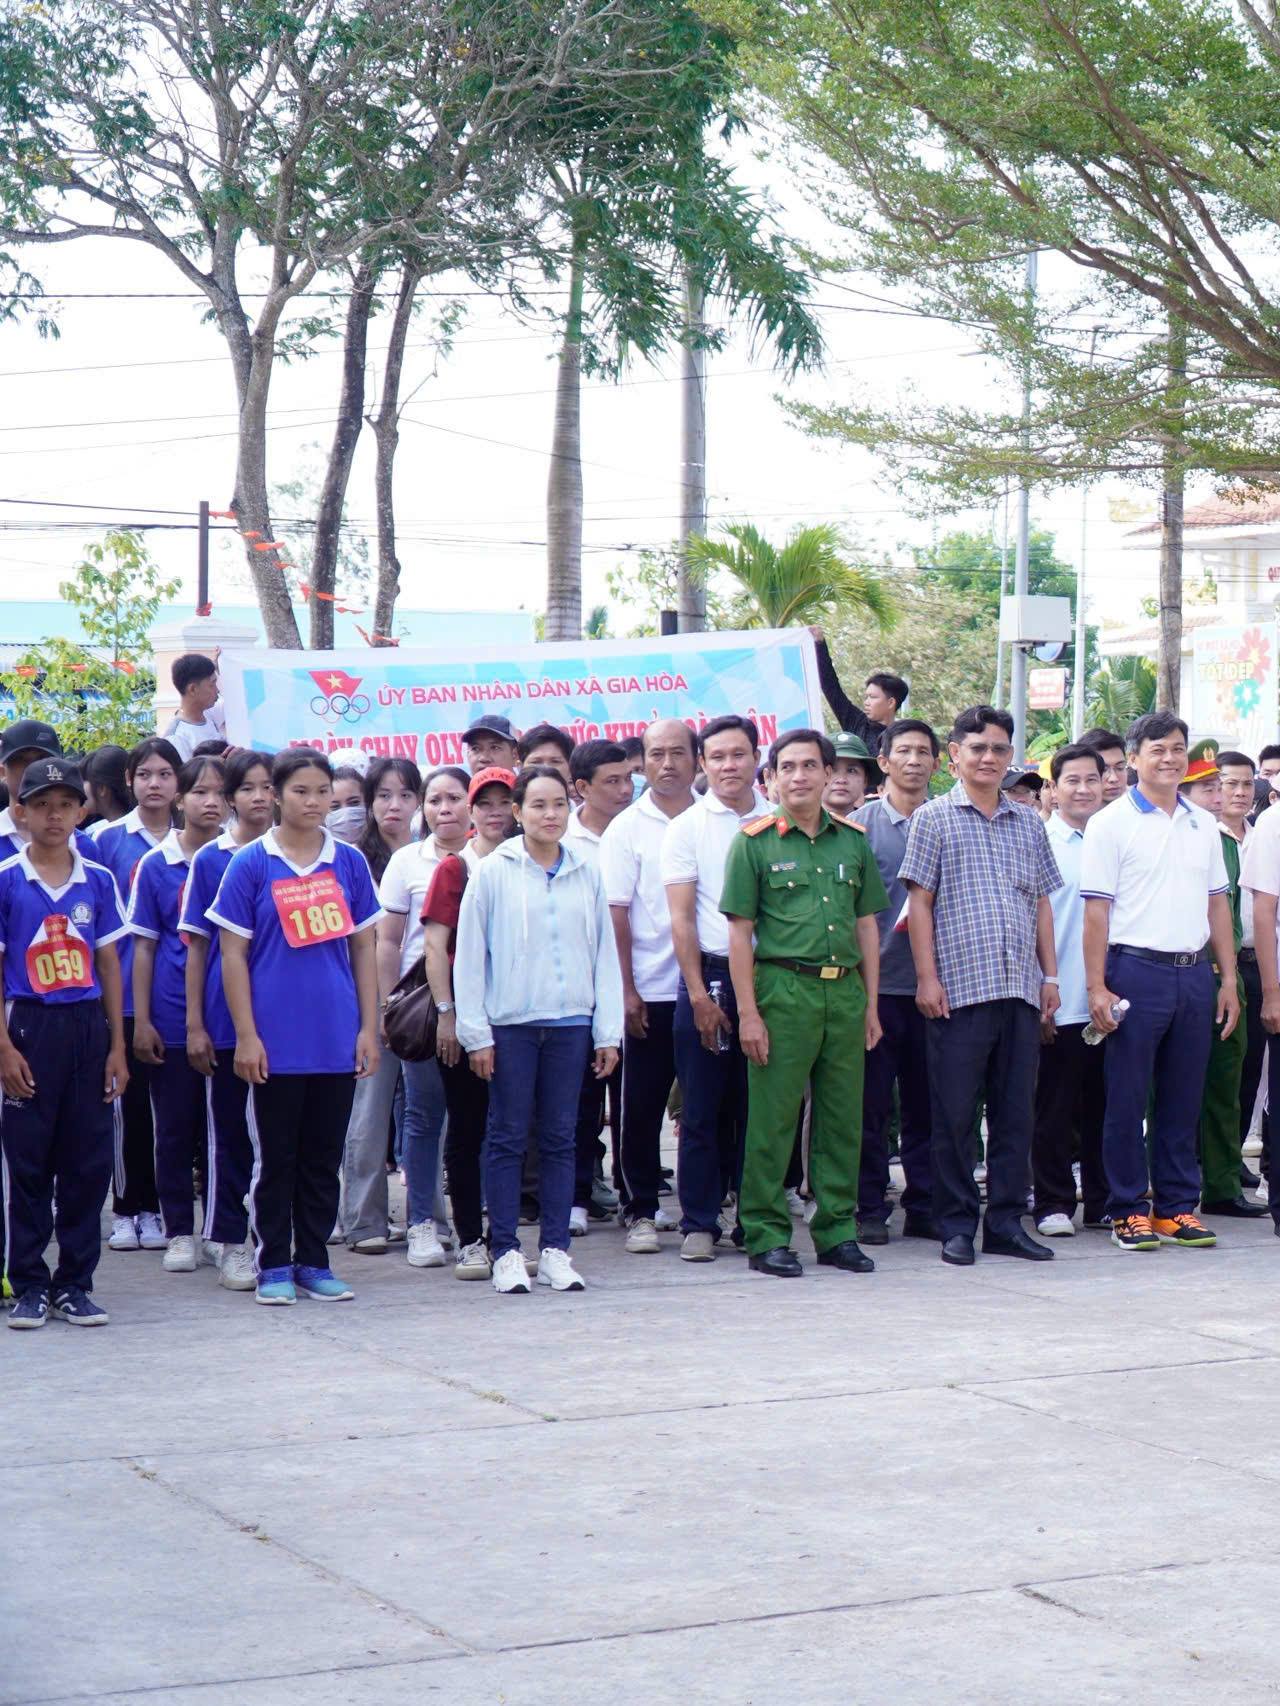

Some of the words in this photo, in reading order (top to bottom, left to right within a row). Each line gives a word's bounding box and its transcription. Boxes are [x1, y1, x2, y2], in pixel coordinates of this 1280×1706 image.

[378, 685, 406, 706] ỦY
[412, 687, 456, 704] BAN
[463, 681, 521, 702] NHÂN
[527, 679, 570, 698] DÂN
[576, 676, 603, 695] XÃ
[607, 677, 641, 694] GIA
[645, 672, 688, 692] HÒA
[47, 764, 63, 780] LA
[288, 902, 343, 939] 186
[35, 949, 84, 985] 059
